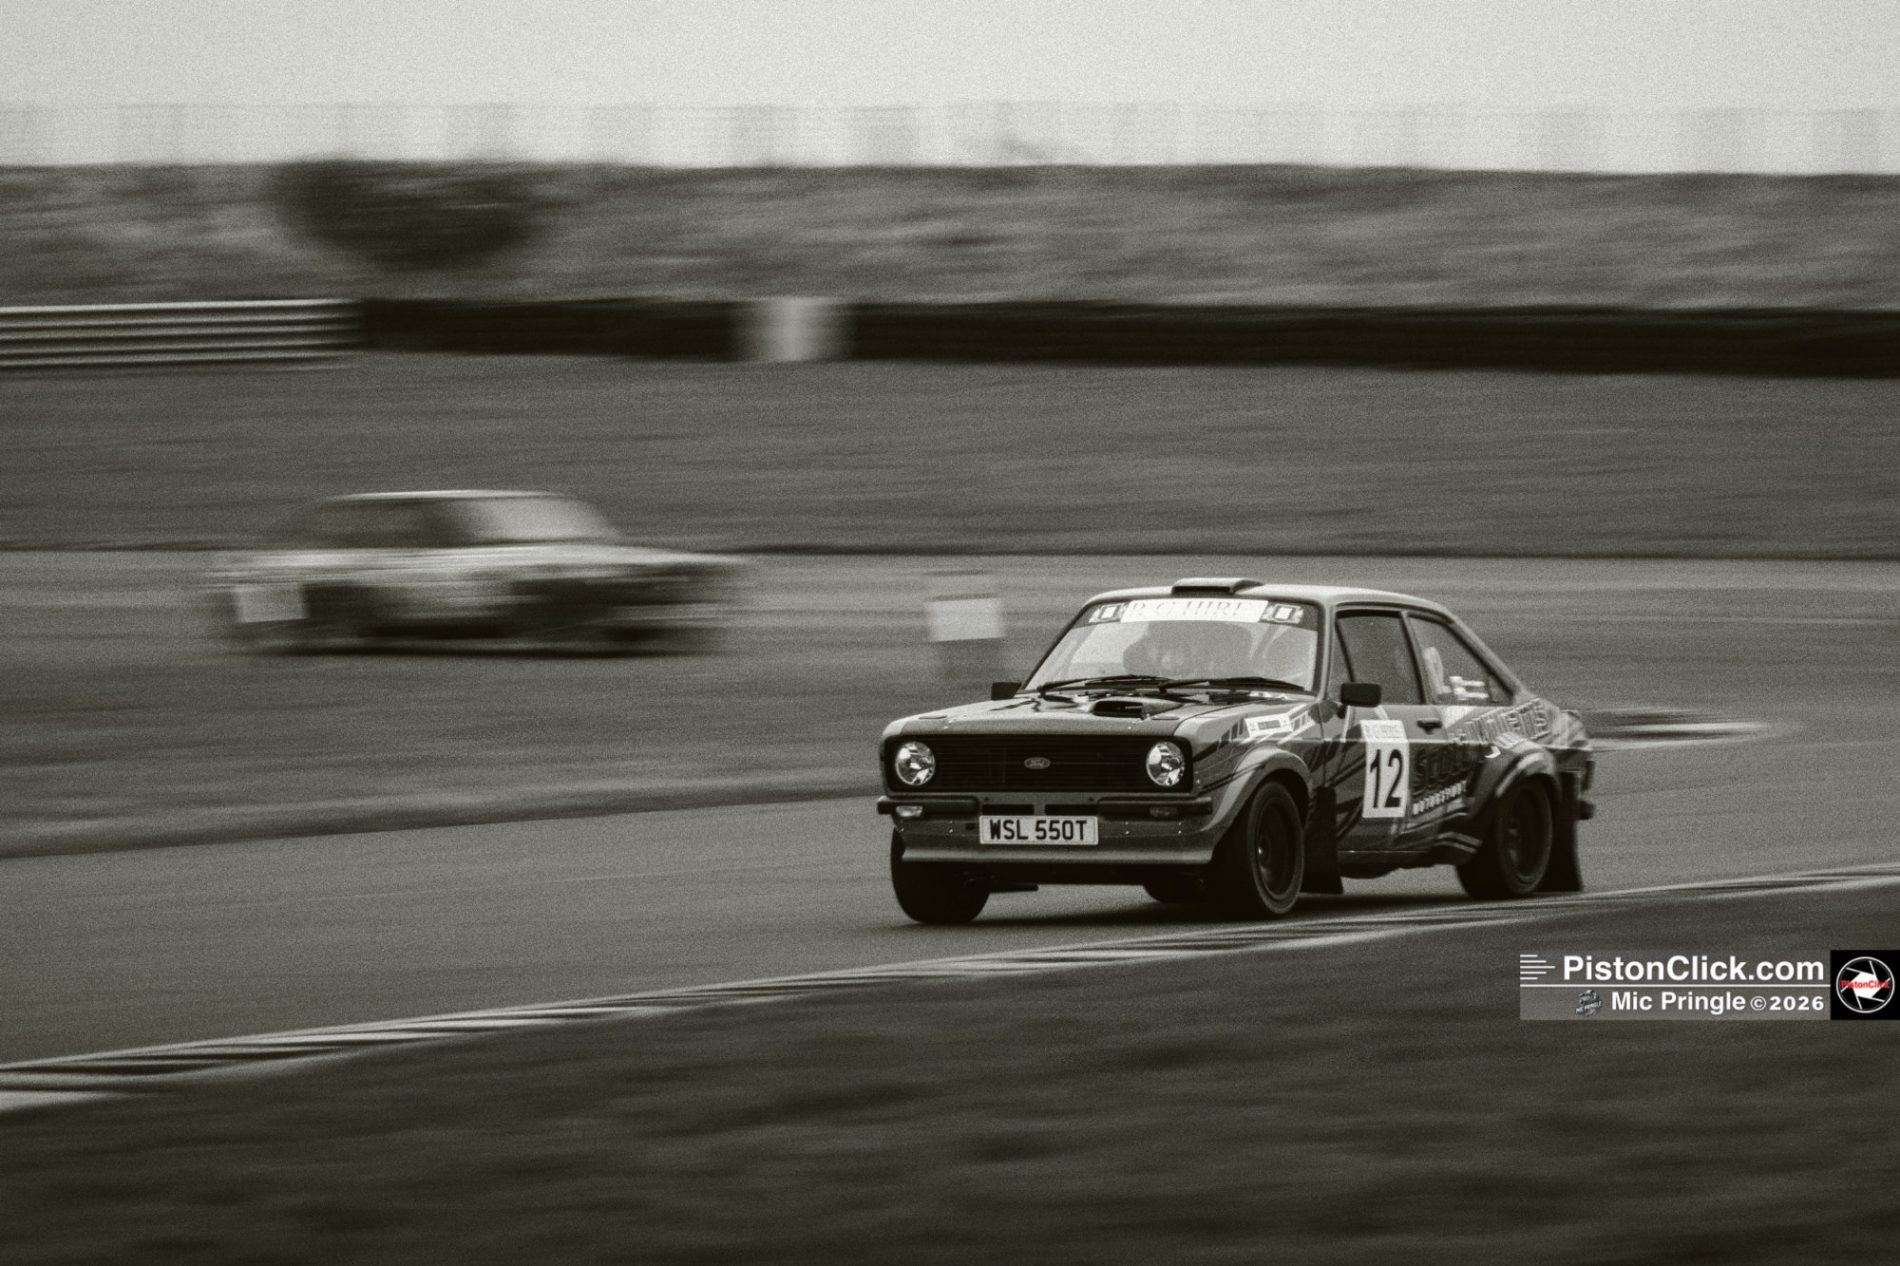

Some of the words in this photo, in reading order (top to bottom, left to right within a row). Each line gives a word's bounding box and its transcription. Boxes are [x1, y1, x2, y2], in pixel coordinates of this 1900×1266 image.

[1370, 749, 1403, 808] 12
[990, 819, 1028, 840] WSL
[1035, 820, 1087, 840] 550T
